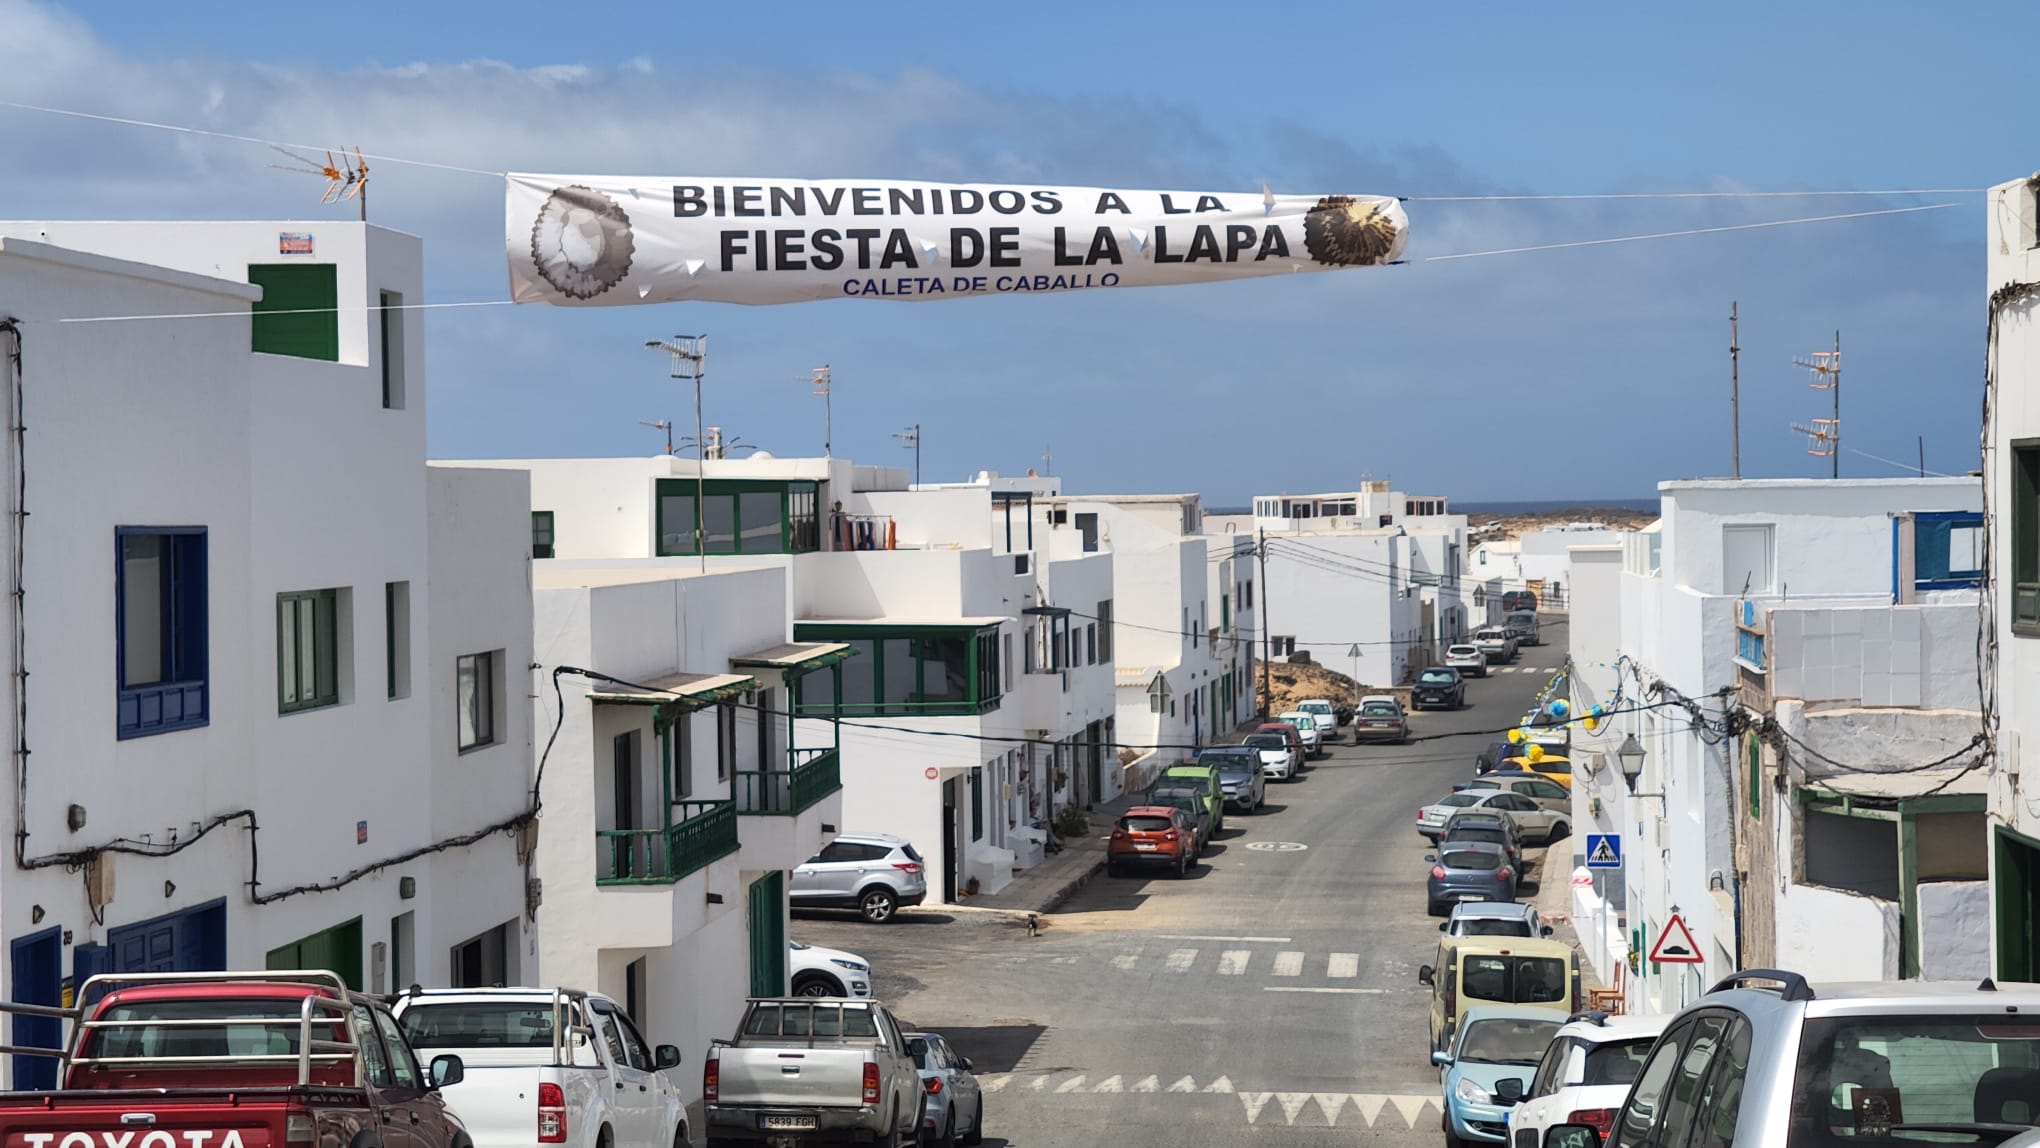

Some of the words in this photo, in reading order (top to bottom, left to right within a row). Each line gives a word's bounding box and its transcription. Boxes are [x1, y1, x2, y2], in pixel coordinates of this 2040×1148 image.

[673, 185, 1063, 218] BIENVENIDOS
[1095, 192, 1131, 215] A
[1160, 193, 1232, 214] LA
[720, 228, 919, 272] FIESTA
[950, 226, 1022, 269] DE
[1053, 226, 1123, 266] LA
[1153, 224, 1290, 264] LAPA
[842, 277, 946, 296] CALETA
[952, 276, 988, 292] DE
[995, 272, 1121, 292] CABALLO
